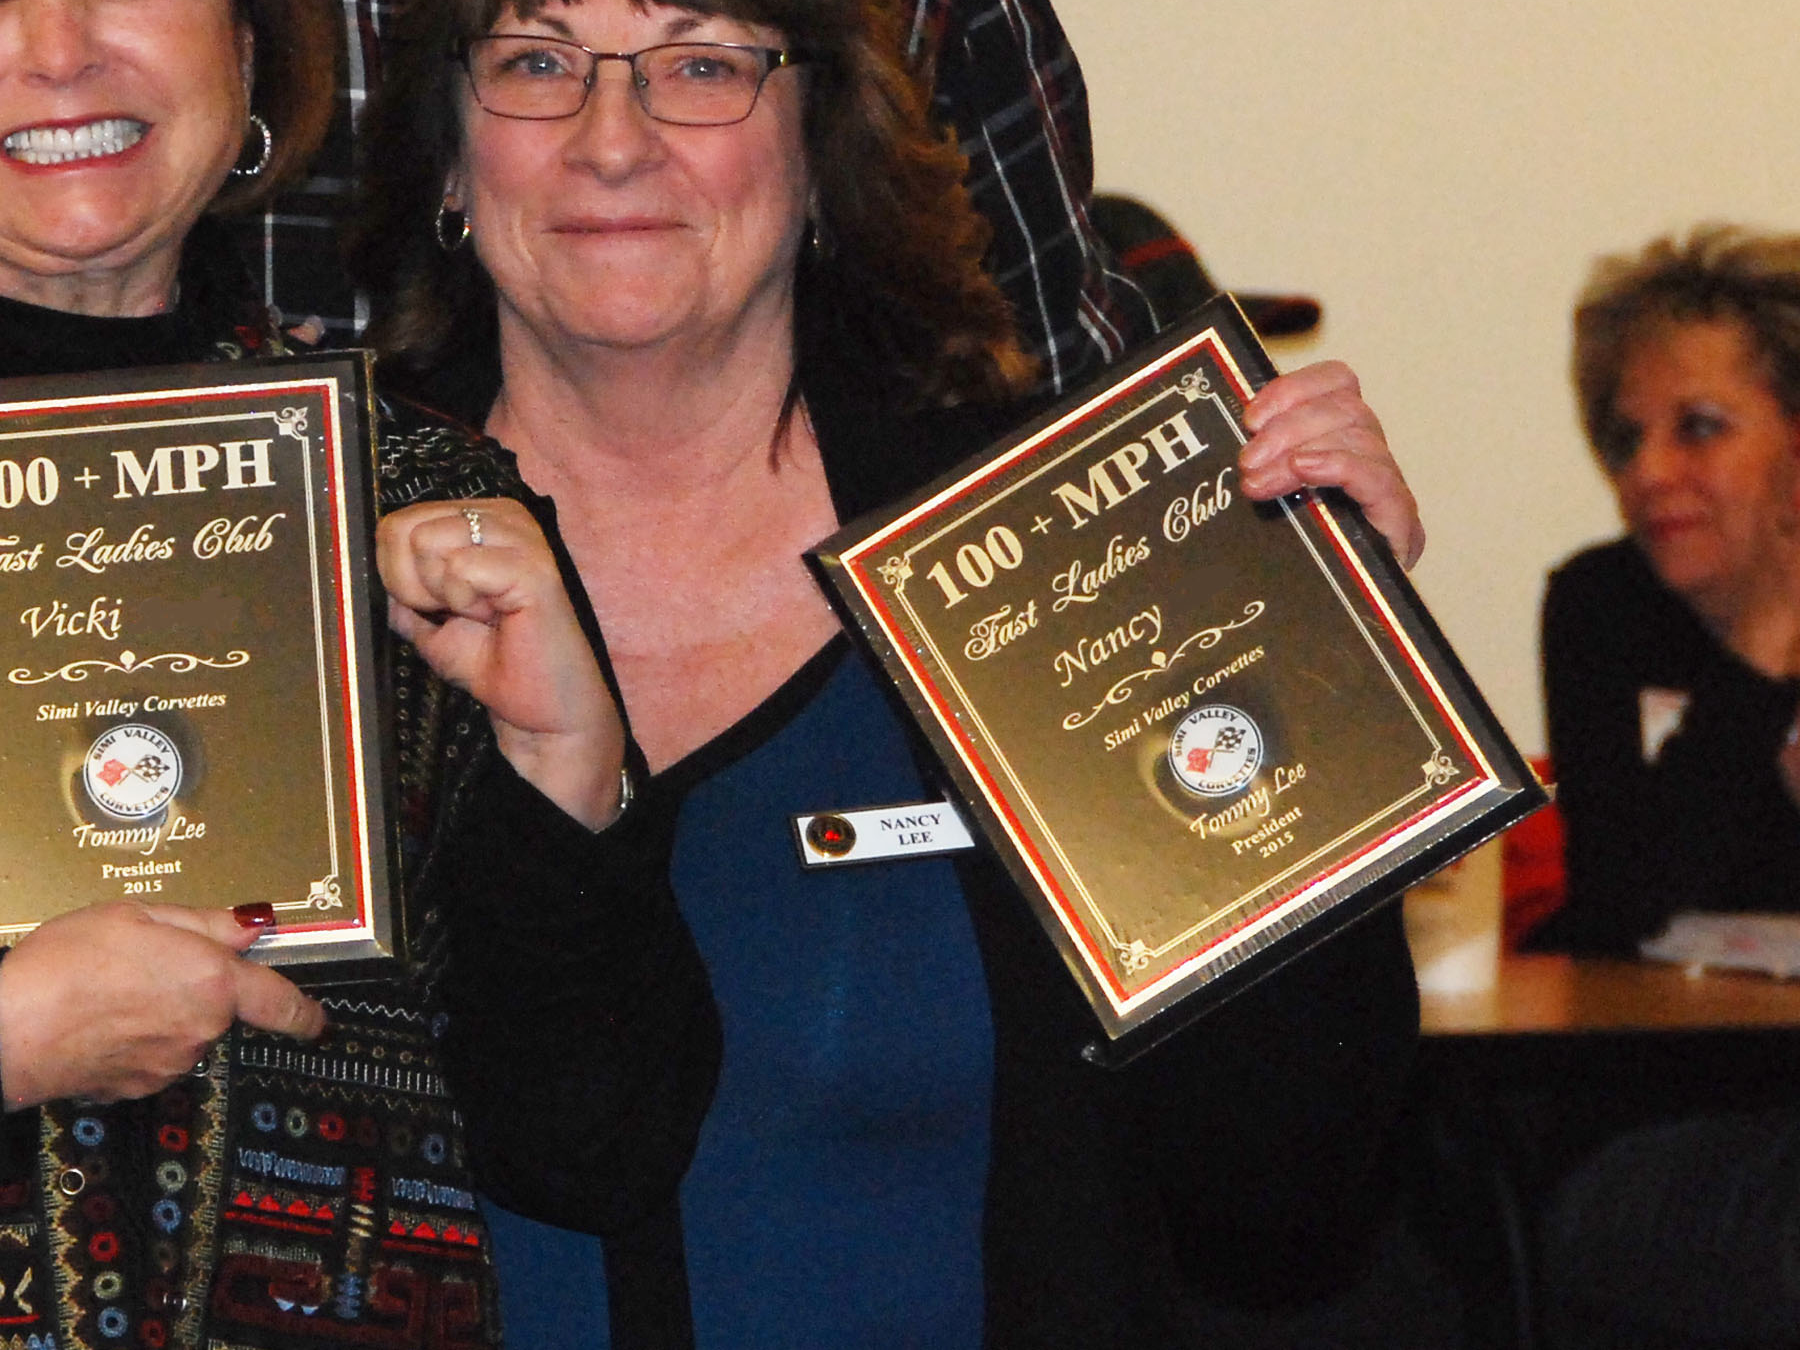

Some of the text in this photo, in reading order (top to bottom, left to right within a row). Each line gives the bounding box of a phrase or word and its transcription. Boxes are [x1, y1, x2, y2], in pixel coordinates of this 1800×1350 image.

[74, 466, 100, 488] +
[111, 439, 275, 499] MPH
[926, 409, 1209, 609] 100 + MPH
[56, 524, 174, 573] Ladies
[192, 513, 286, 559] Club
[964, 467, 1233, 661] Fast Ladies Club
[20, 596, 122, 640] Vicki
[1054, 605, 1162, 688] Nancy
[36, 693, 226, 721] Simi Valley Corvettes
[1104, 645, 1265, 751] Simi Valley Corvettes
[1189, 710, 1238, 724] VALLEY
[93, 729, 170, 760] SIMI VALLEY
[100, 786, 169, 812] CORVETTES
[1190, 762, 1307, 840] Tommy Lee
[73, 816, 206, 855] Tommy Lee
[880, 814, 941, 831] NANCY
[898, 831, 933, 845] LEE
[1231, 806, 1302, 855] President
[1259, 832, 1294, 858] 2015
[102, 861, 181, 879] President
[124, 880, 162, 894] 2015
